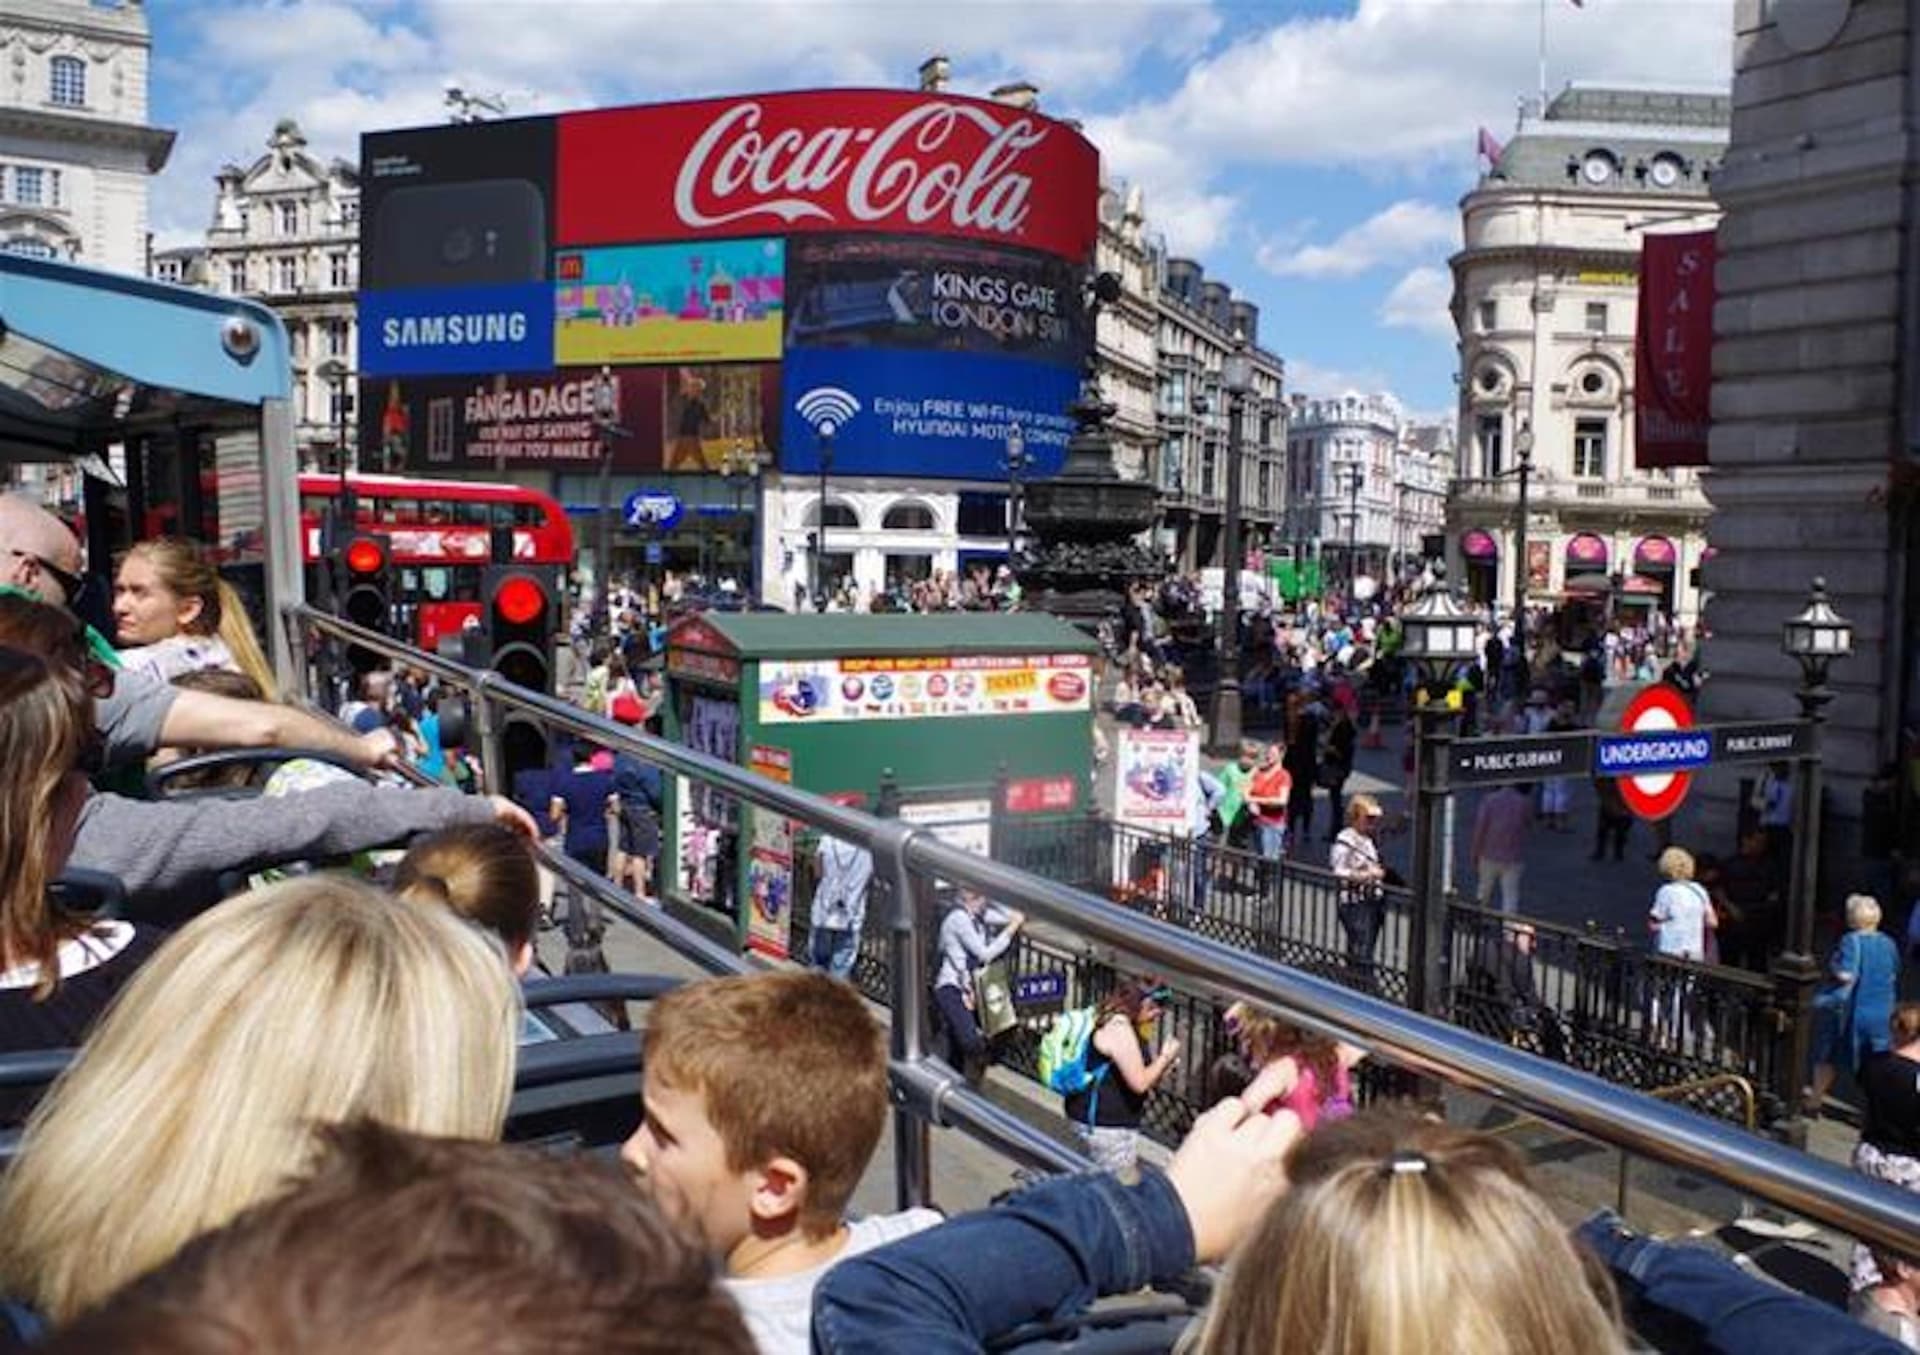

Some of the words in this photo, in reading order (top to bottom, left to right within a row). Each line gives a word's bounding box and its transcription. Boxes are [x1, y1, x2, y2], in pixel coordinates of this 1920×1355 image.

[674, 102, 1048, 231] Coca-Cola
[933, 272, 1008, 304] KINGS
[1011, 281, 1056, 314] GATE
[383, 311, 526, 347] SAMSUNG
[931, 300, 1035, 339] LONDON
[873, 397, 920, 418] Enjoy
[923, 399, 965, 418] FREE
[892, 418, 969, 437] HYUNDAI
[1600, 738, 1709, 765] UNDERGROUND
[1726, 735, 1758, 752] PUBLIC
[1474, 752, 1515, 770] PUBLIC
[1515, 749, 1562, 767] SUBWAY
